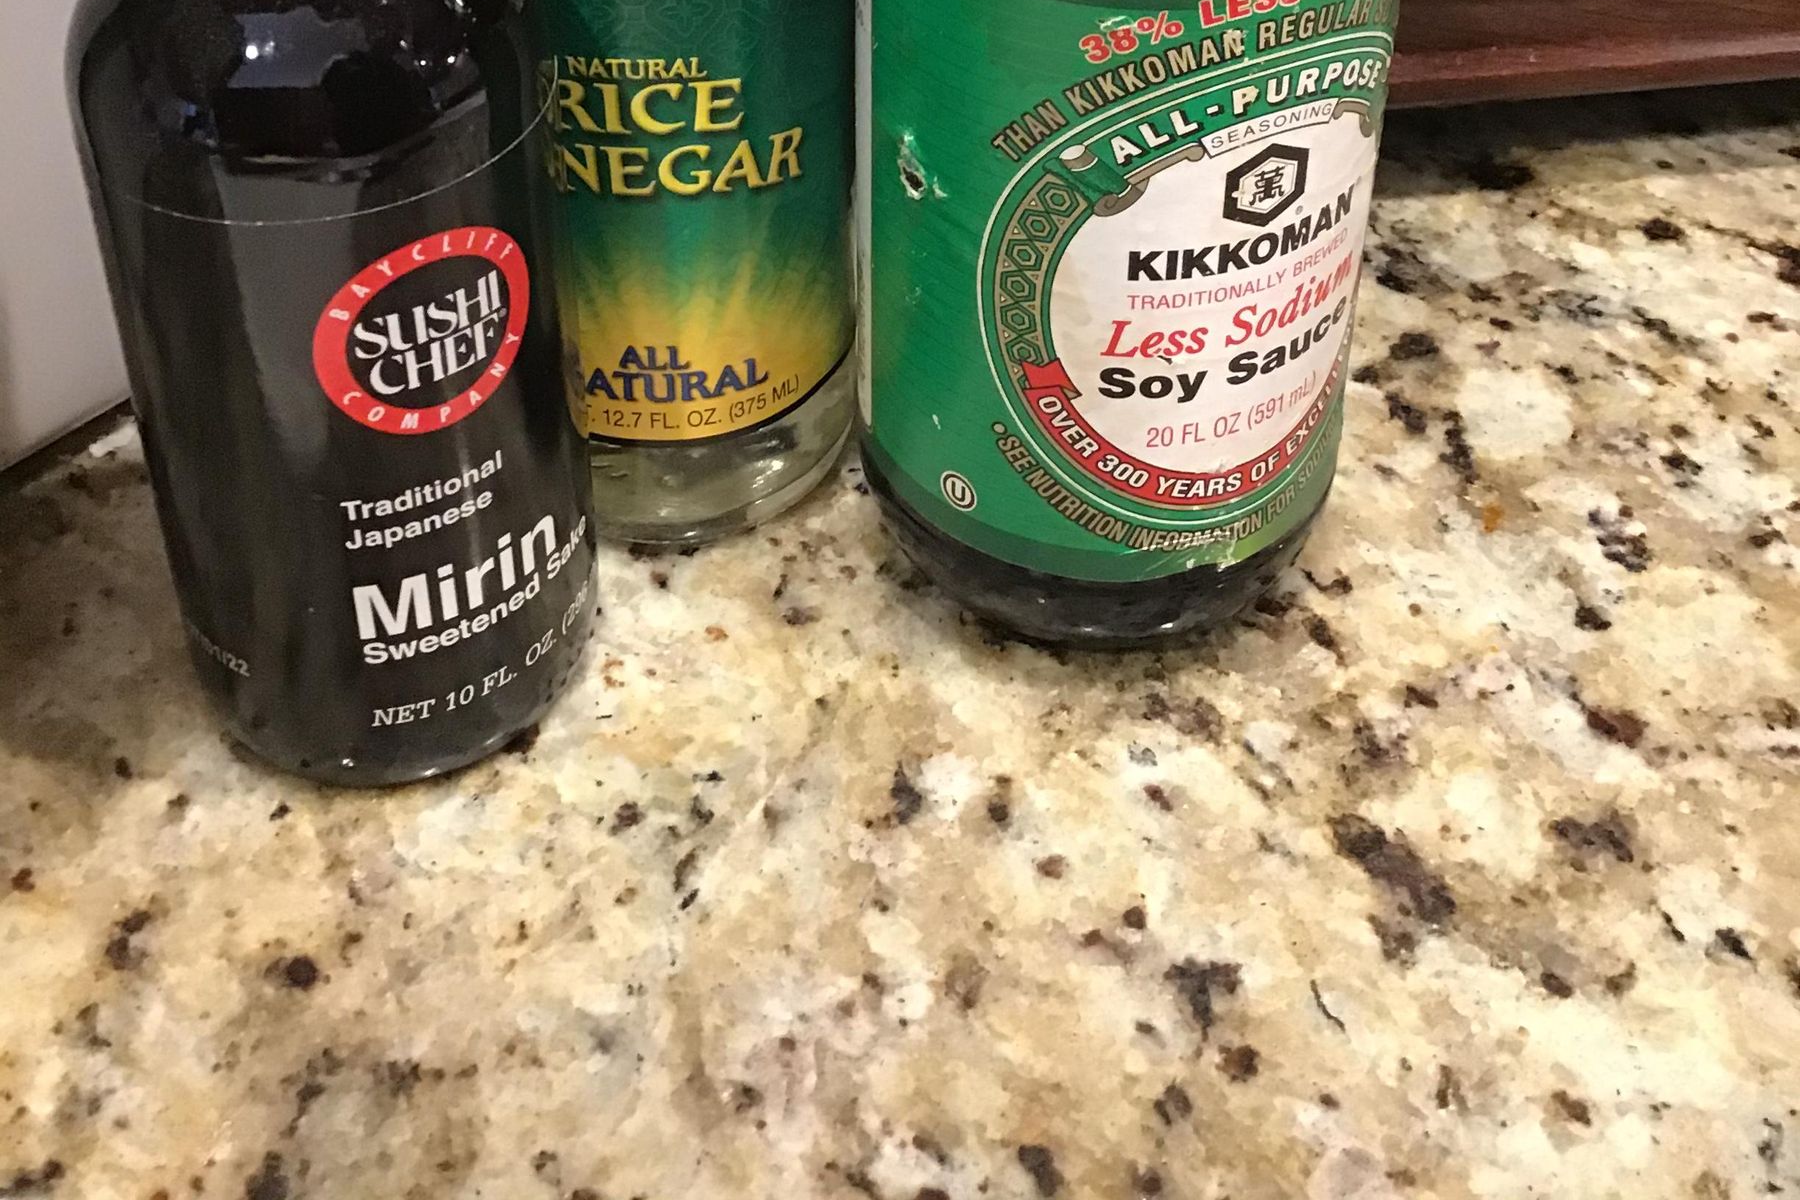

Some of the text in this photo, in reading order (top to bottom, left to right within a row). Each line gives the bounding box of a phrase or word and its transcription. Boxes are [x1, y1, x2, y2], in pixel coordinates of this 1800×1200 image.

[565, 56, 707, 80] NATURAL
[1079, 10, 1184, 64] 38%
[553, 78, 744, 135] RICE
[991, 99, 1066, 162] THAN
[1064, 28, 1246, 115] KIKKOMAN
[1210, 103, 1334, 150] SEASONING
[555, 126, 802, 198] NEGAR
[1127, 182, 1356, 281] KIKKOMAN
[1127, 227, 1349, 310] TRADITIONALLY BREWED
[328, 231, 514, 322] BAYCLIFF
[353, 269, 502, 360] SUSHI
[1100, 254, 1352, 359] Less Sodium
[342, 332, 520, 430] COMPANY
[369, 311, 500, 396] CHEF
[585, 358, 769, 403] ATURAL
[618, 345, 691, 371] ALL
[1098, 295, 1348, 403] Soy Sauce
[603, 407, 642, 429] 12.7
[650, 411, 680, 429] FL.
[686, 408, 722, 428] OZ.
[729, 393, 767, 422] (375
[772, 375, 799, 404] ML)
[1146, 426, 1174, 448] 20
[1181, 422, 1206, 445] FL
[1213, 411, 1241, 438] OZ
[1247, 397, 1285, 432] (591
[339, 449, 502, 521] Traditional
[1037, 394, 1101, 460] OVER
[1097, 454, 1150, 489] 300
[1155, 472, 1243, 500] YEARS
[1250, 449, 1282, 483] OF
[344, 490, 493, 550] Japanese
[997, 434, 1036, 475] SEE
[1023, 466, 1130, 544] NUTRITION
[1127, 510, 1264, 552] INFORMATION
[1265, 487, 1297, 523] FOR
[352, 514, 557, 640] Mirin
[362, 514, 586, 665] Sweetened Sake
[370, 698, 437, 728] NET
[445, 685, 474, 712] 10
[481, 665, 519, 697] FL.
[525, 628, 558, 667] OZ.
